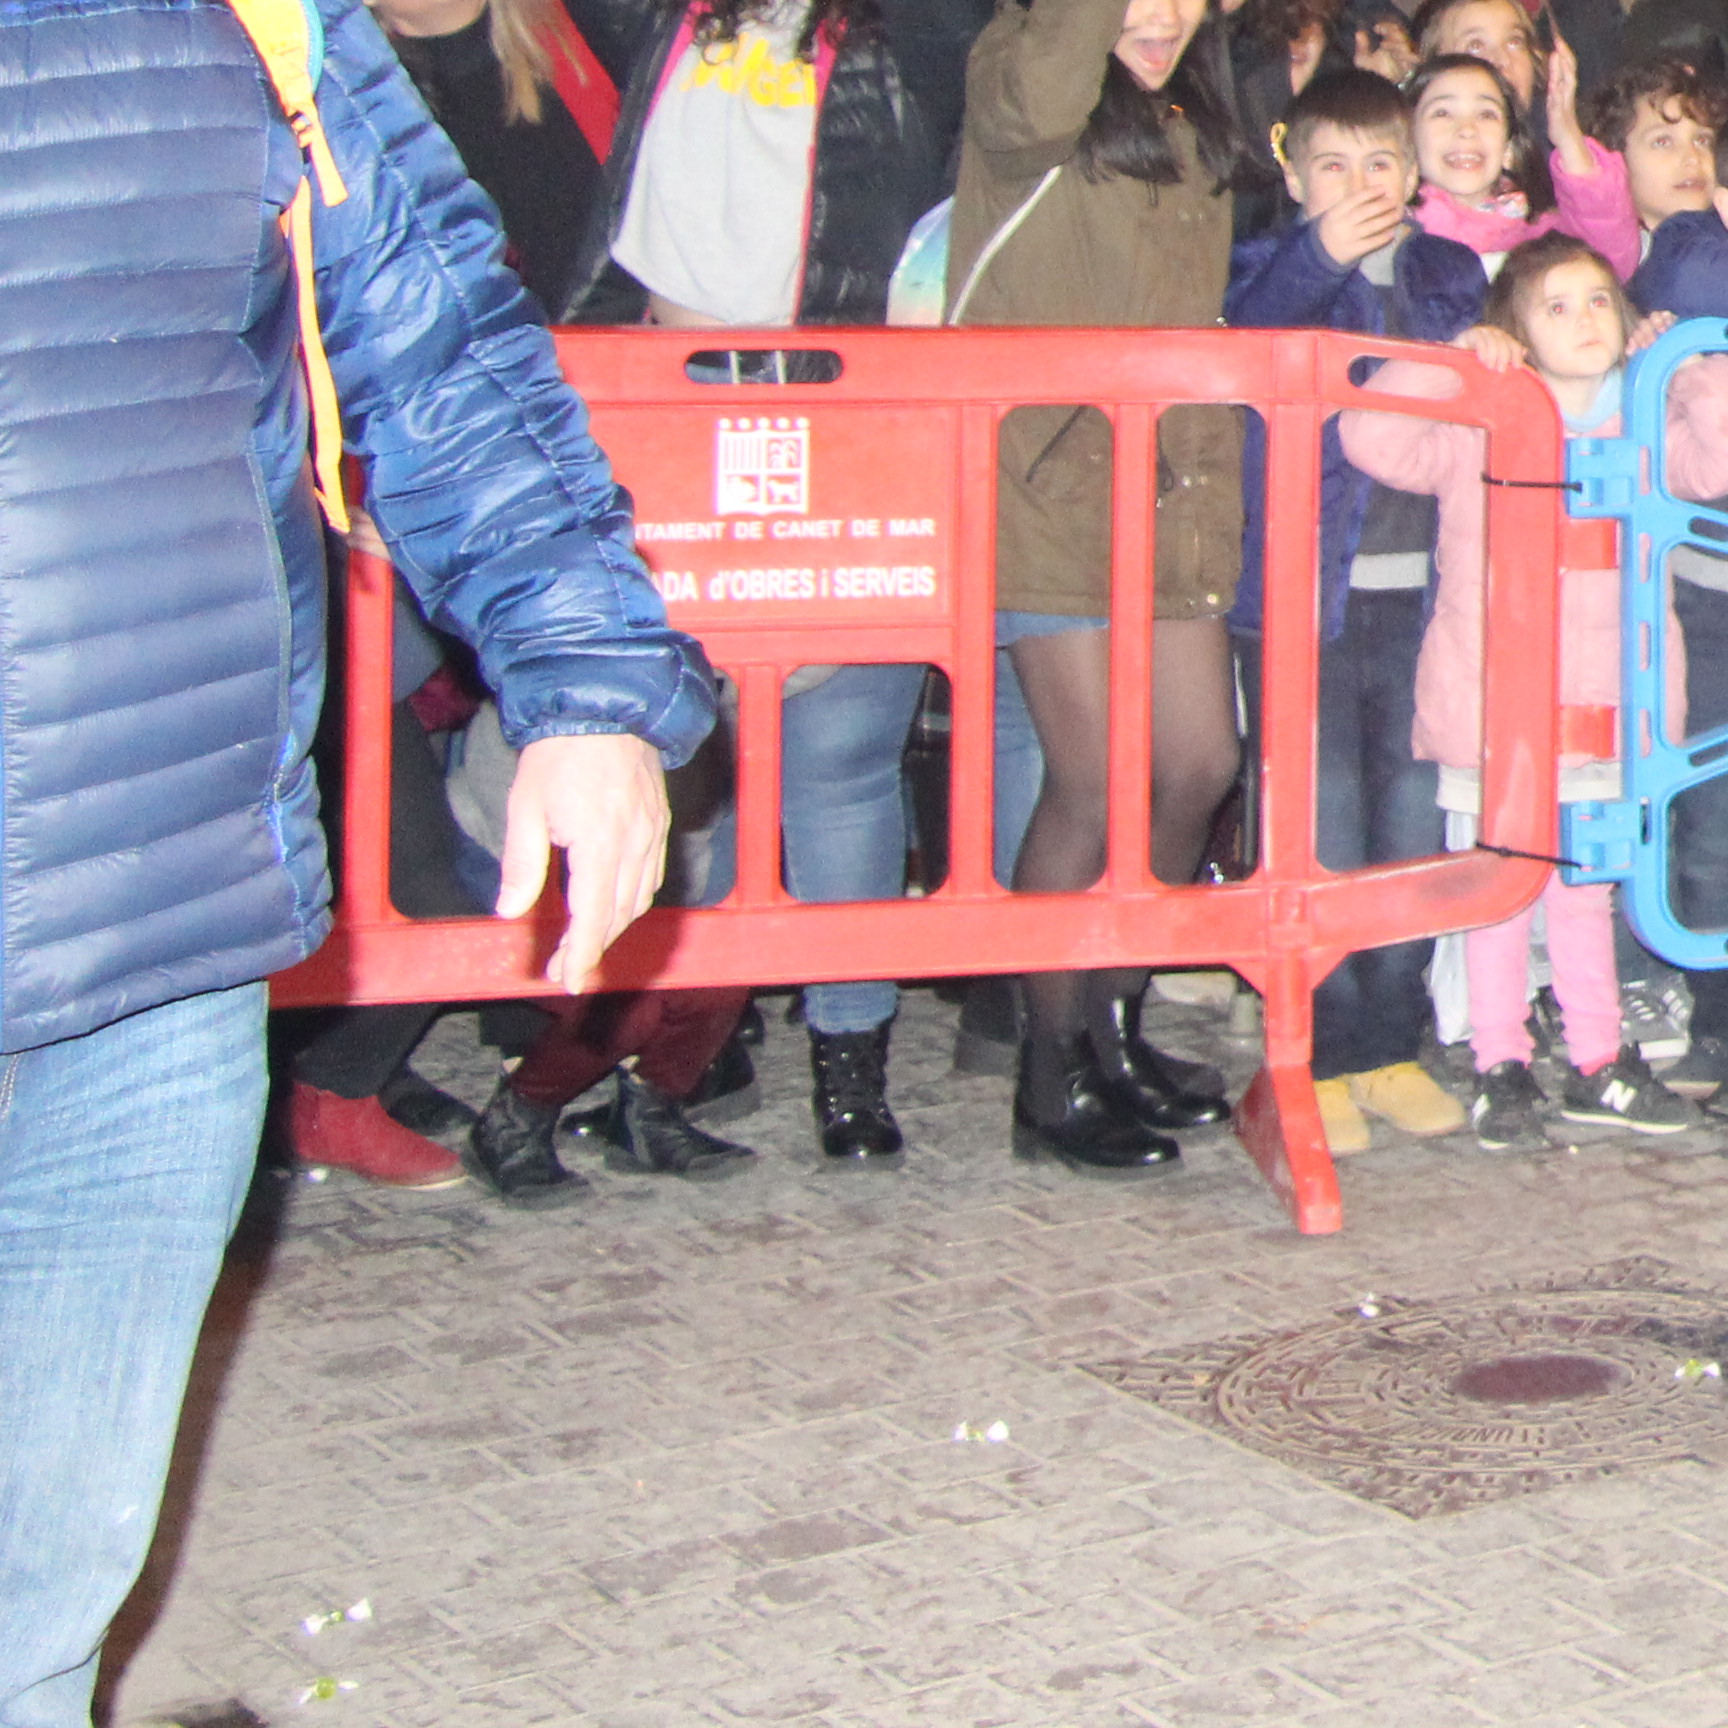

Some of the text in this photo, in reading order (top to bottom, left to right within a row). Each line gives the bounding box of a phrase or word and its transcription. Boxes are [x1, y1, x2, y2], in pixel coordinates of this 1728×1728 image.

[733, 520, 763, 540] DE
[772, 519, 843, 540] CANET
[851, 519, 881, 538] DE
[889, 518, 936, 538] MAR
[708, 568, 816, 601] d'OBRES
[820, 569, 830, 599] i
[833, 565, 937, 598] SERVEIS
